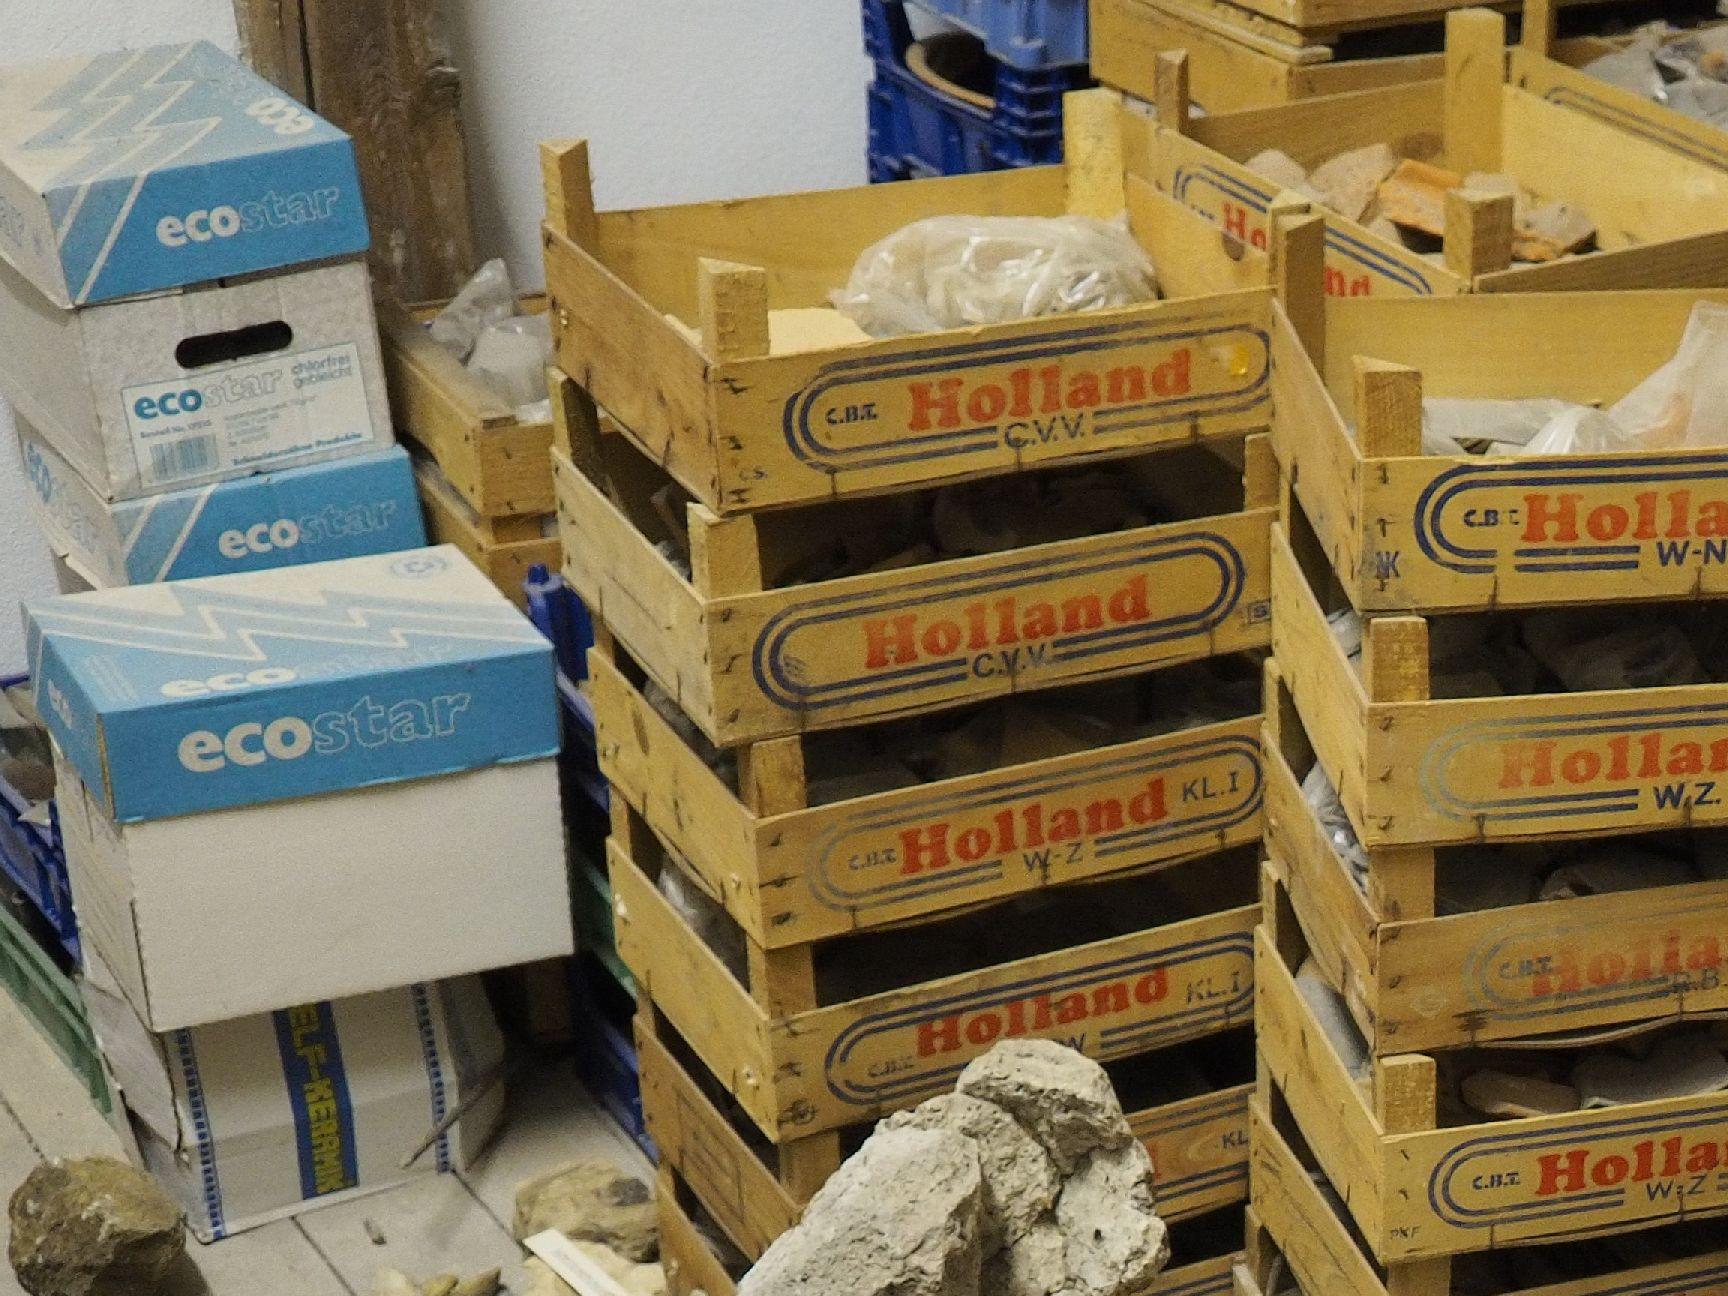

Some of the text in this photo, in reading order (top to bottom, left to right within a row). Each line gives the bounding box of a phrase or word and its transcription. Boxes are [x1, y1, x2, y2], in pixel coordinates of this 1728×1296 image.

[156, 187, 341, 247] ecostar
[133, 368, 284, 420] ecostar
[907, 349, 1192, 431] Holland
[218, 499, 397, 558] ecostar
[863, 575, 1151, 669] Holland
[178, 692, 471, 773] ecostar
[900, 779, 1169, 876] Holland
[916, 968, 1169, 1058] Holland
